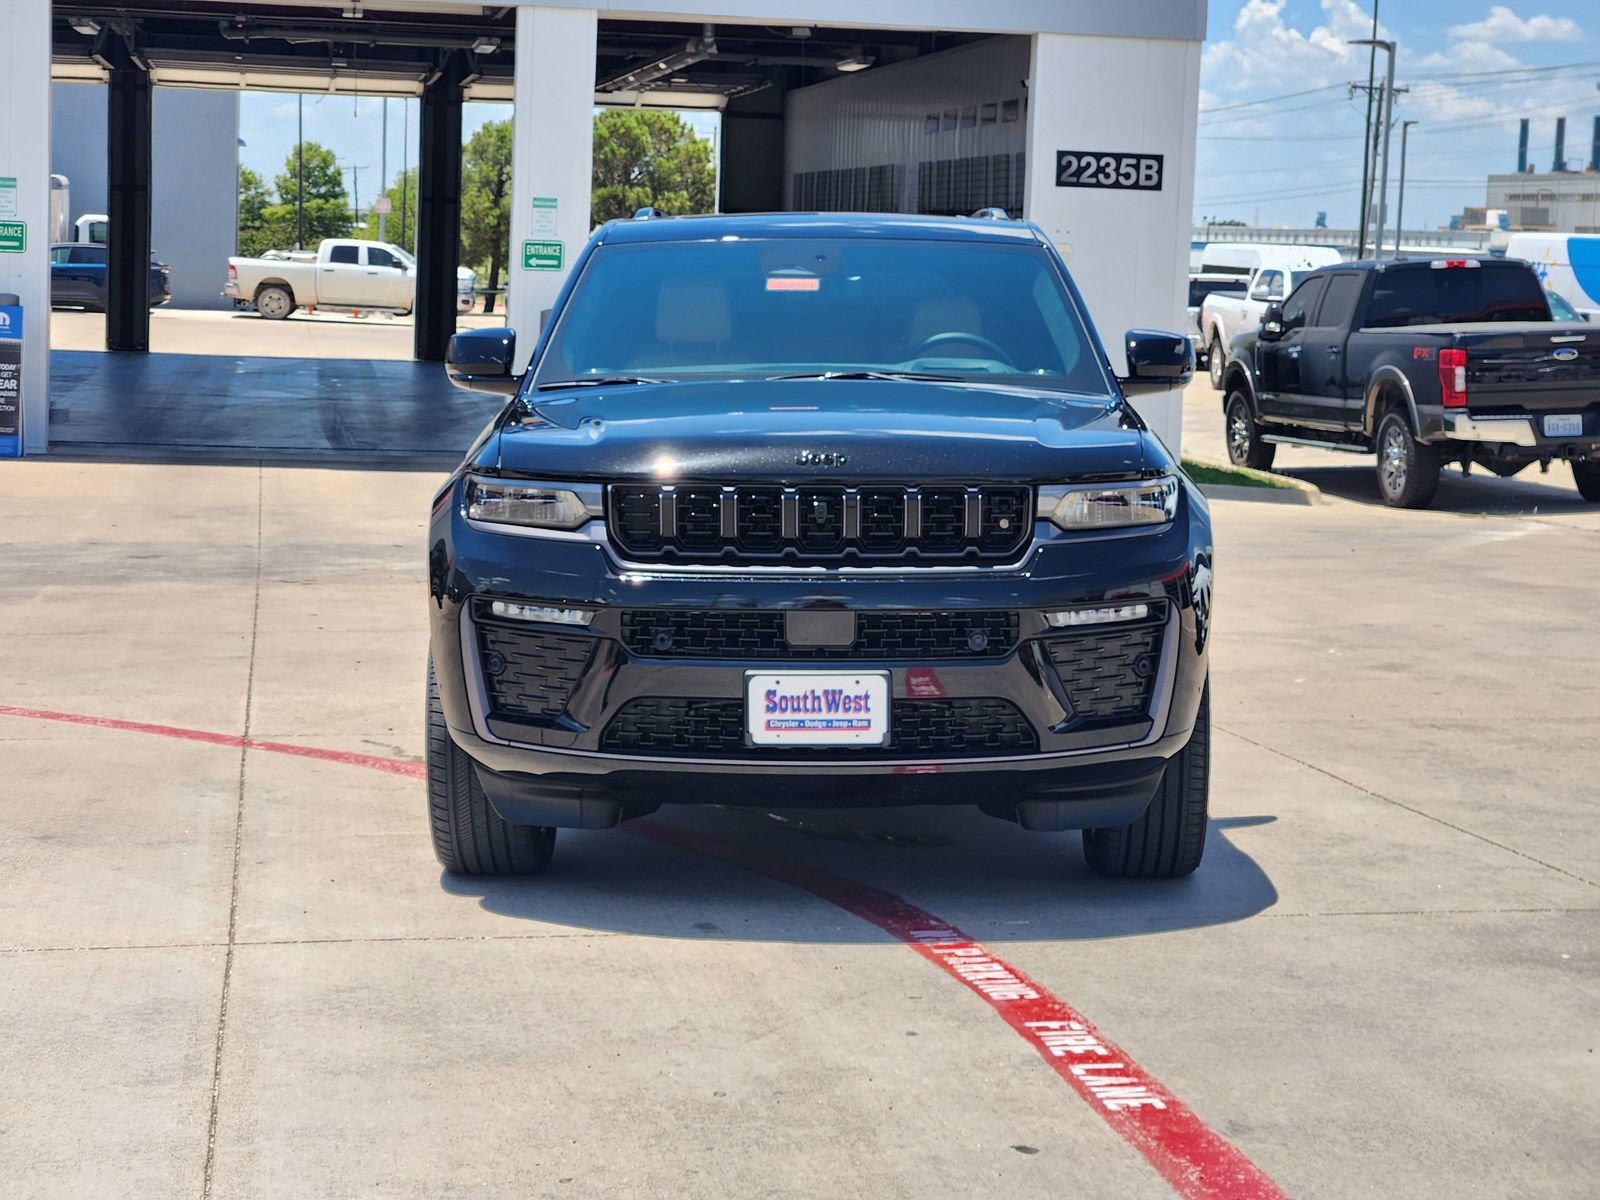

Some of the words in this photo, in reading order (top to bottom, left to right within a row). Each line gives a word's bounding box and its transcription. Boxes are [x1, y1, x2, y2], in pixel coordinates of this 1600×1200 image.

[1060, 154, 1159, 187] 2235B
[526, 244, 561, 256] ENTRANCE
[795, 449, 848, 468] Jeep
[765, 689, 871, 714] SouthWest
[770, 719, 799, 729] Chrysler
[804, 719, 827, 729] Dodge
[832, 719, 849, 729] Jeep
[852, 719, 869, 728] Ram
[931, 947, 1041, 1000] PARKING
[1024, 1020, 1110, 1056] FIRE
[1068, 1062, 1168, 1111] LANE
